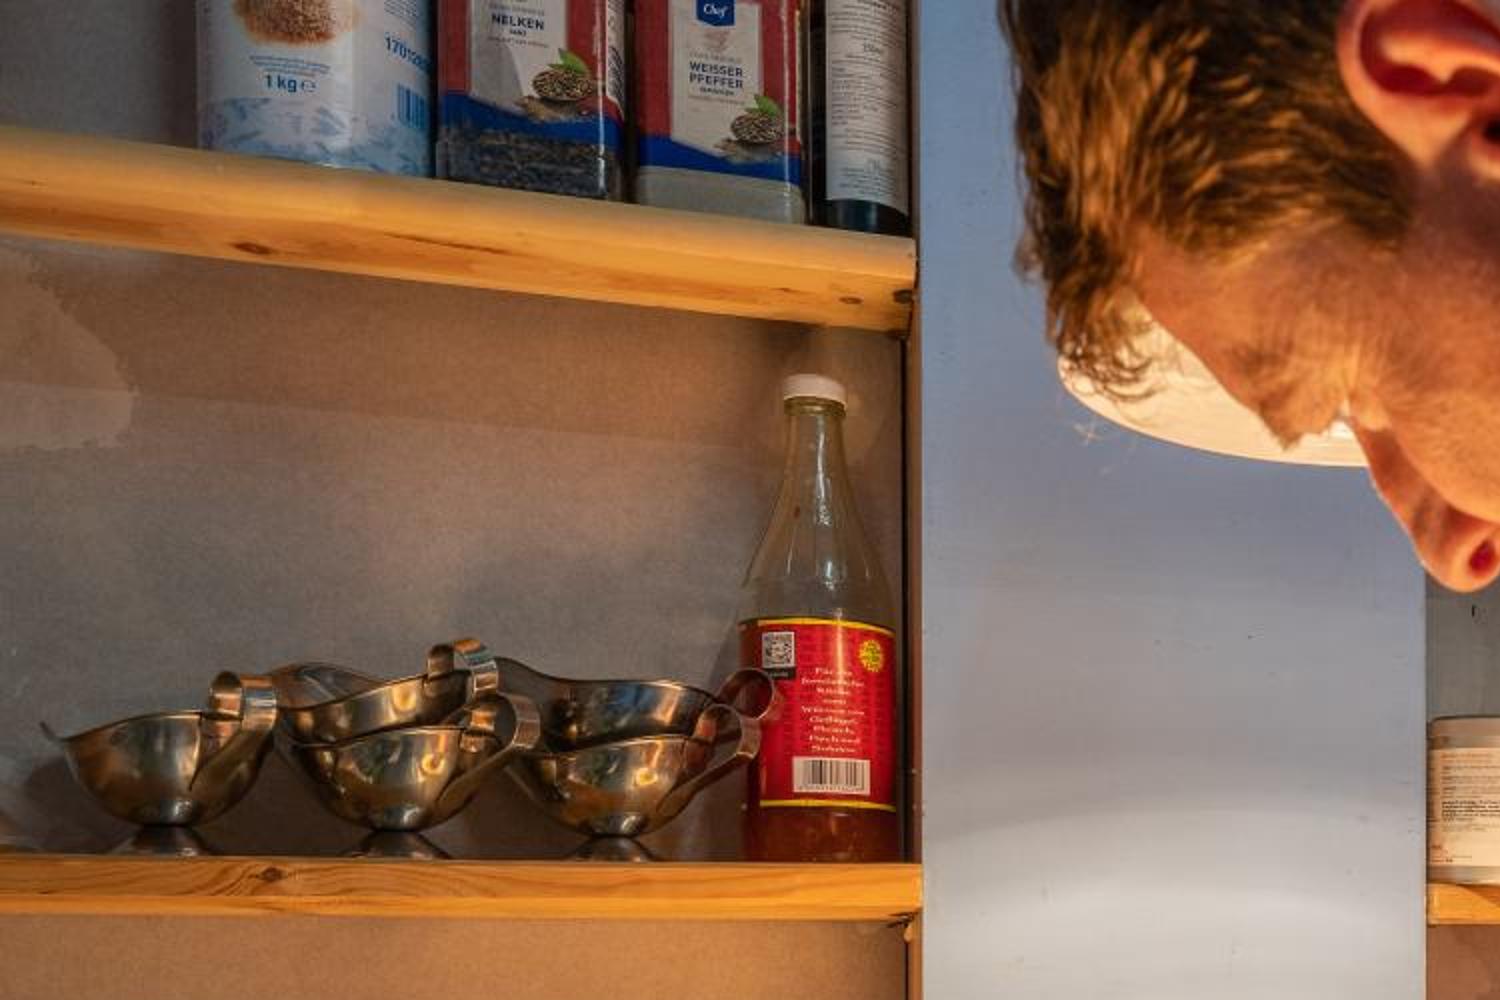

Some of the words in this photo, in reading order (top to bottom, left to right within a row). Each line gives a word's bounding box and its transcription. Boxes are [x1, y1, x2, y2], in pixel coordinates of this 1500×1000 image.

[491, 12, 545, 31] NELKEN
[689, 61, 743, 77] WEISSER
[277, 75, 297, 93] kg
[689, 72, 744, 89] PFEFFER
